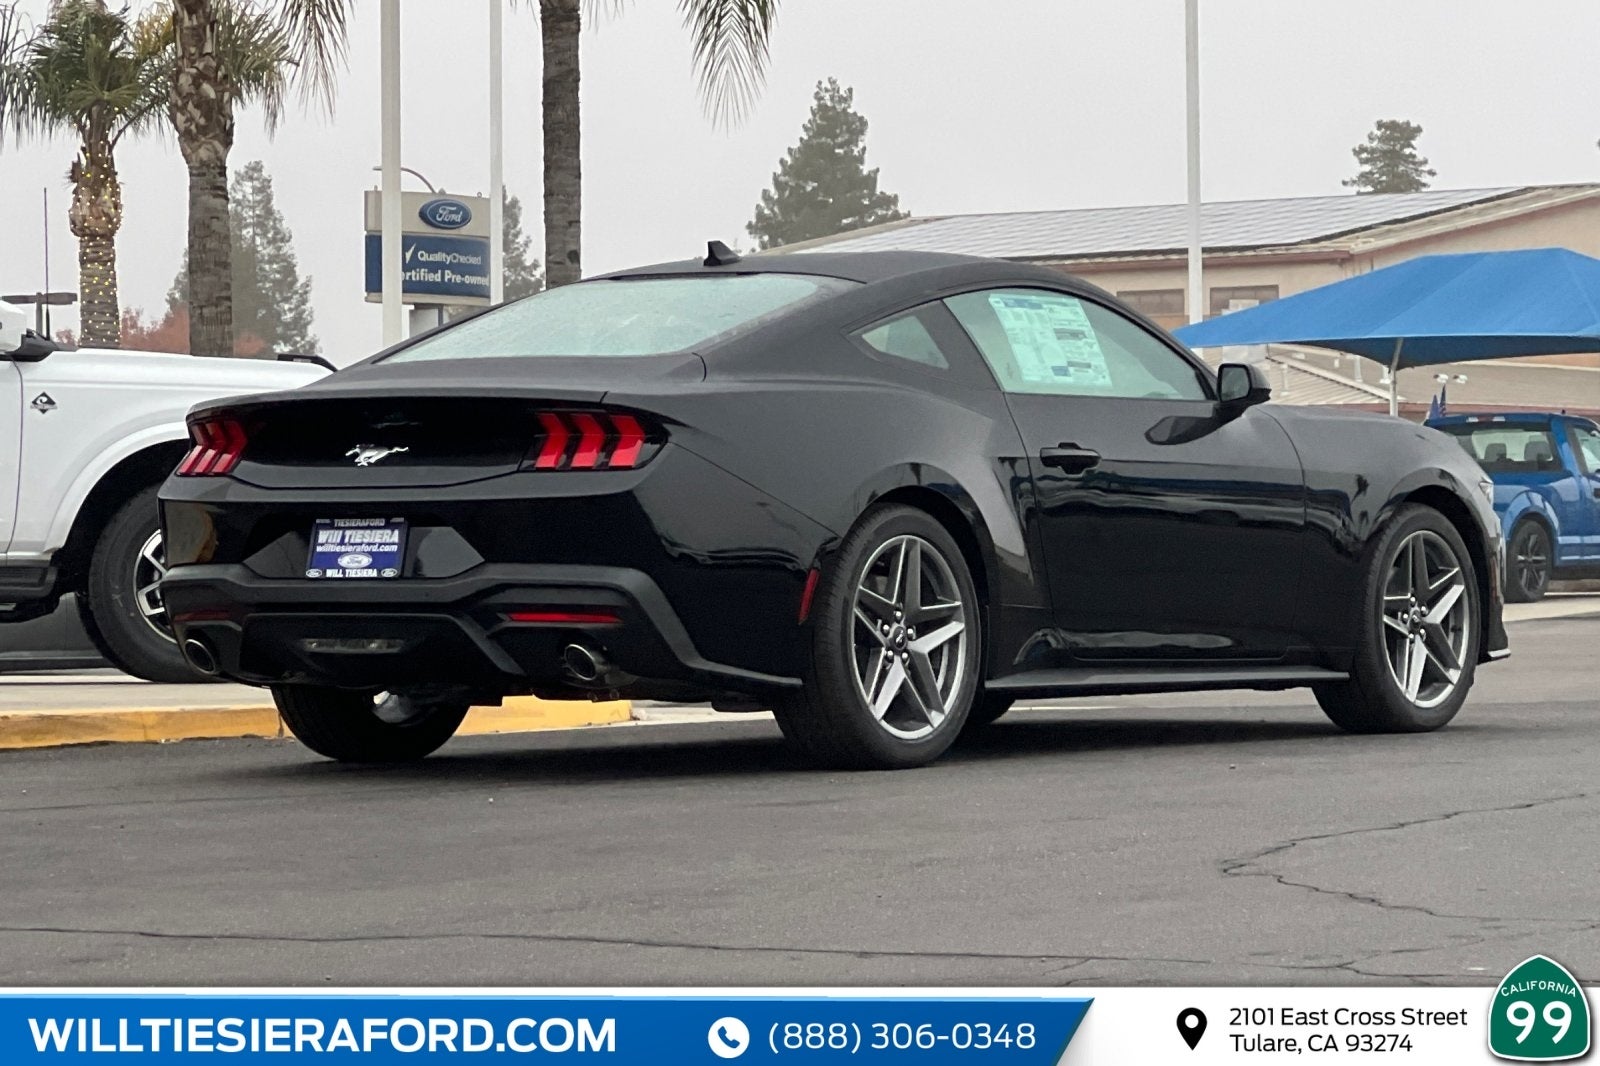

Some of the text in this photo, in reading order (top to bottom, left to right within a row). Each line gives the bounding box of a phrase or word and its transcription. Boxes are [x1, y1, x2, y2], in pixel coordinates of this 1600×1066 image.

[436, 205, 463, 223] Ford
[417, 250, 482, 265] QualityChecked
[401, 268, 441, 283] rtified
